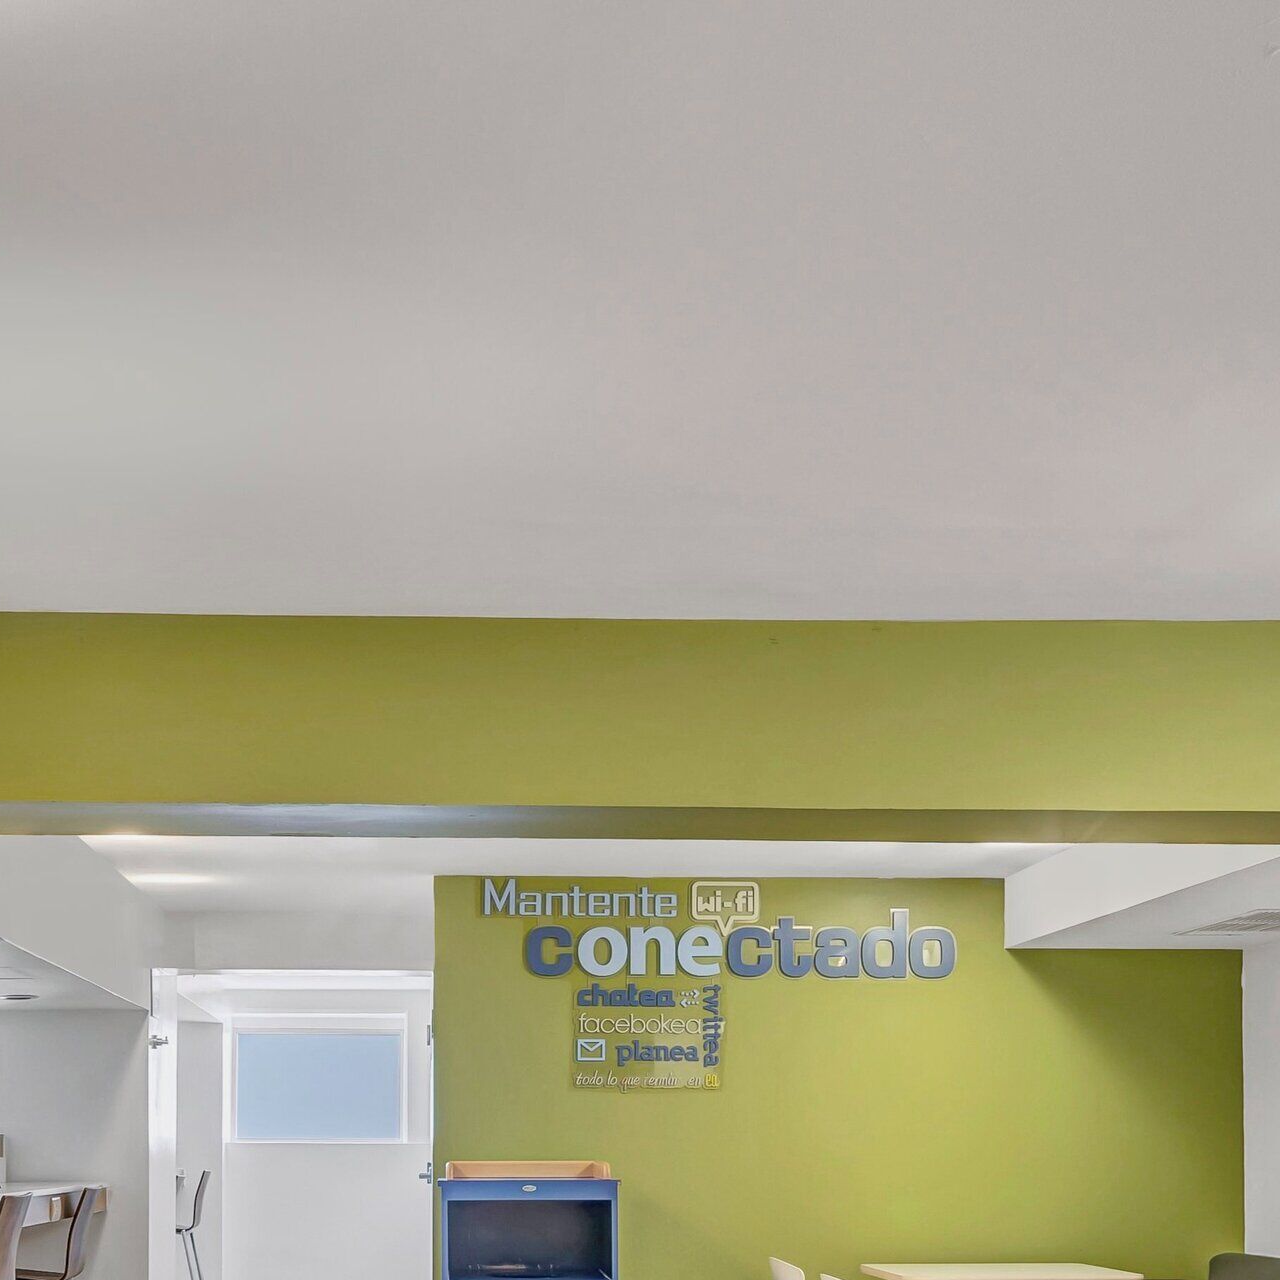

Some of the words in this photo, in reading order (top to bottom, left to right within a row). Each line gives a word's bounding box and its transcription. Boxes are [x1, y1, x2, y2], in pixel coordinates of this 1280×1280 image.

[482, 878, 678, 917] Mantente
[697, 890, 754, 913] wi-fi
[525, 908, 957, 979] conectado
[576, 983, 676, 1008] chatea
[578, 1012, 702, 1034] facebokea
[703, 984, 724, 1068] twittea
[615, 1039, 700, 1067] planea
[575, 1070, 603, 1086] todo
[607, 1070, 618, 1086] lo
[620, 1076, 641, 1091] que
